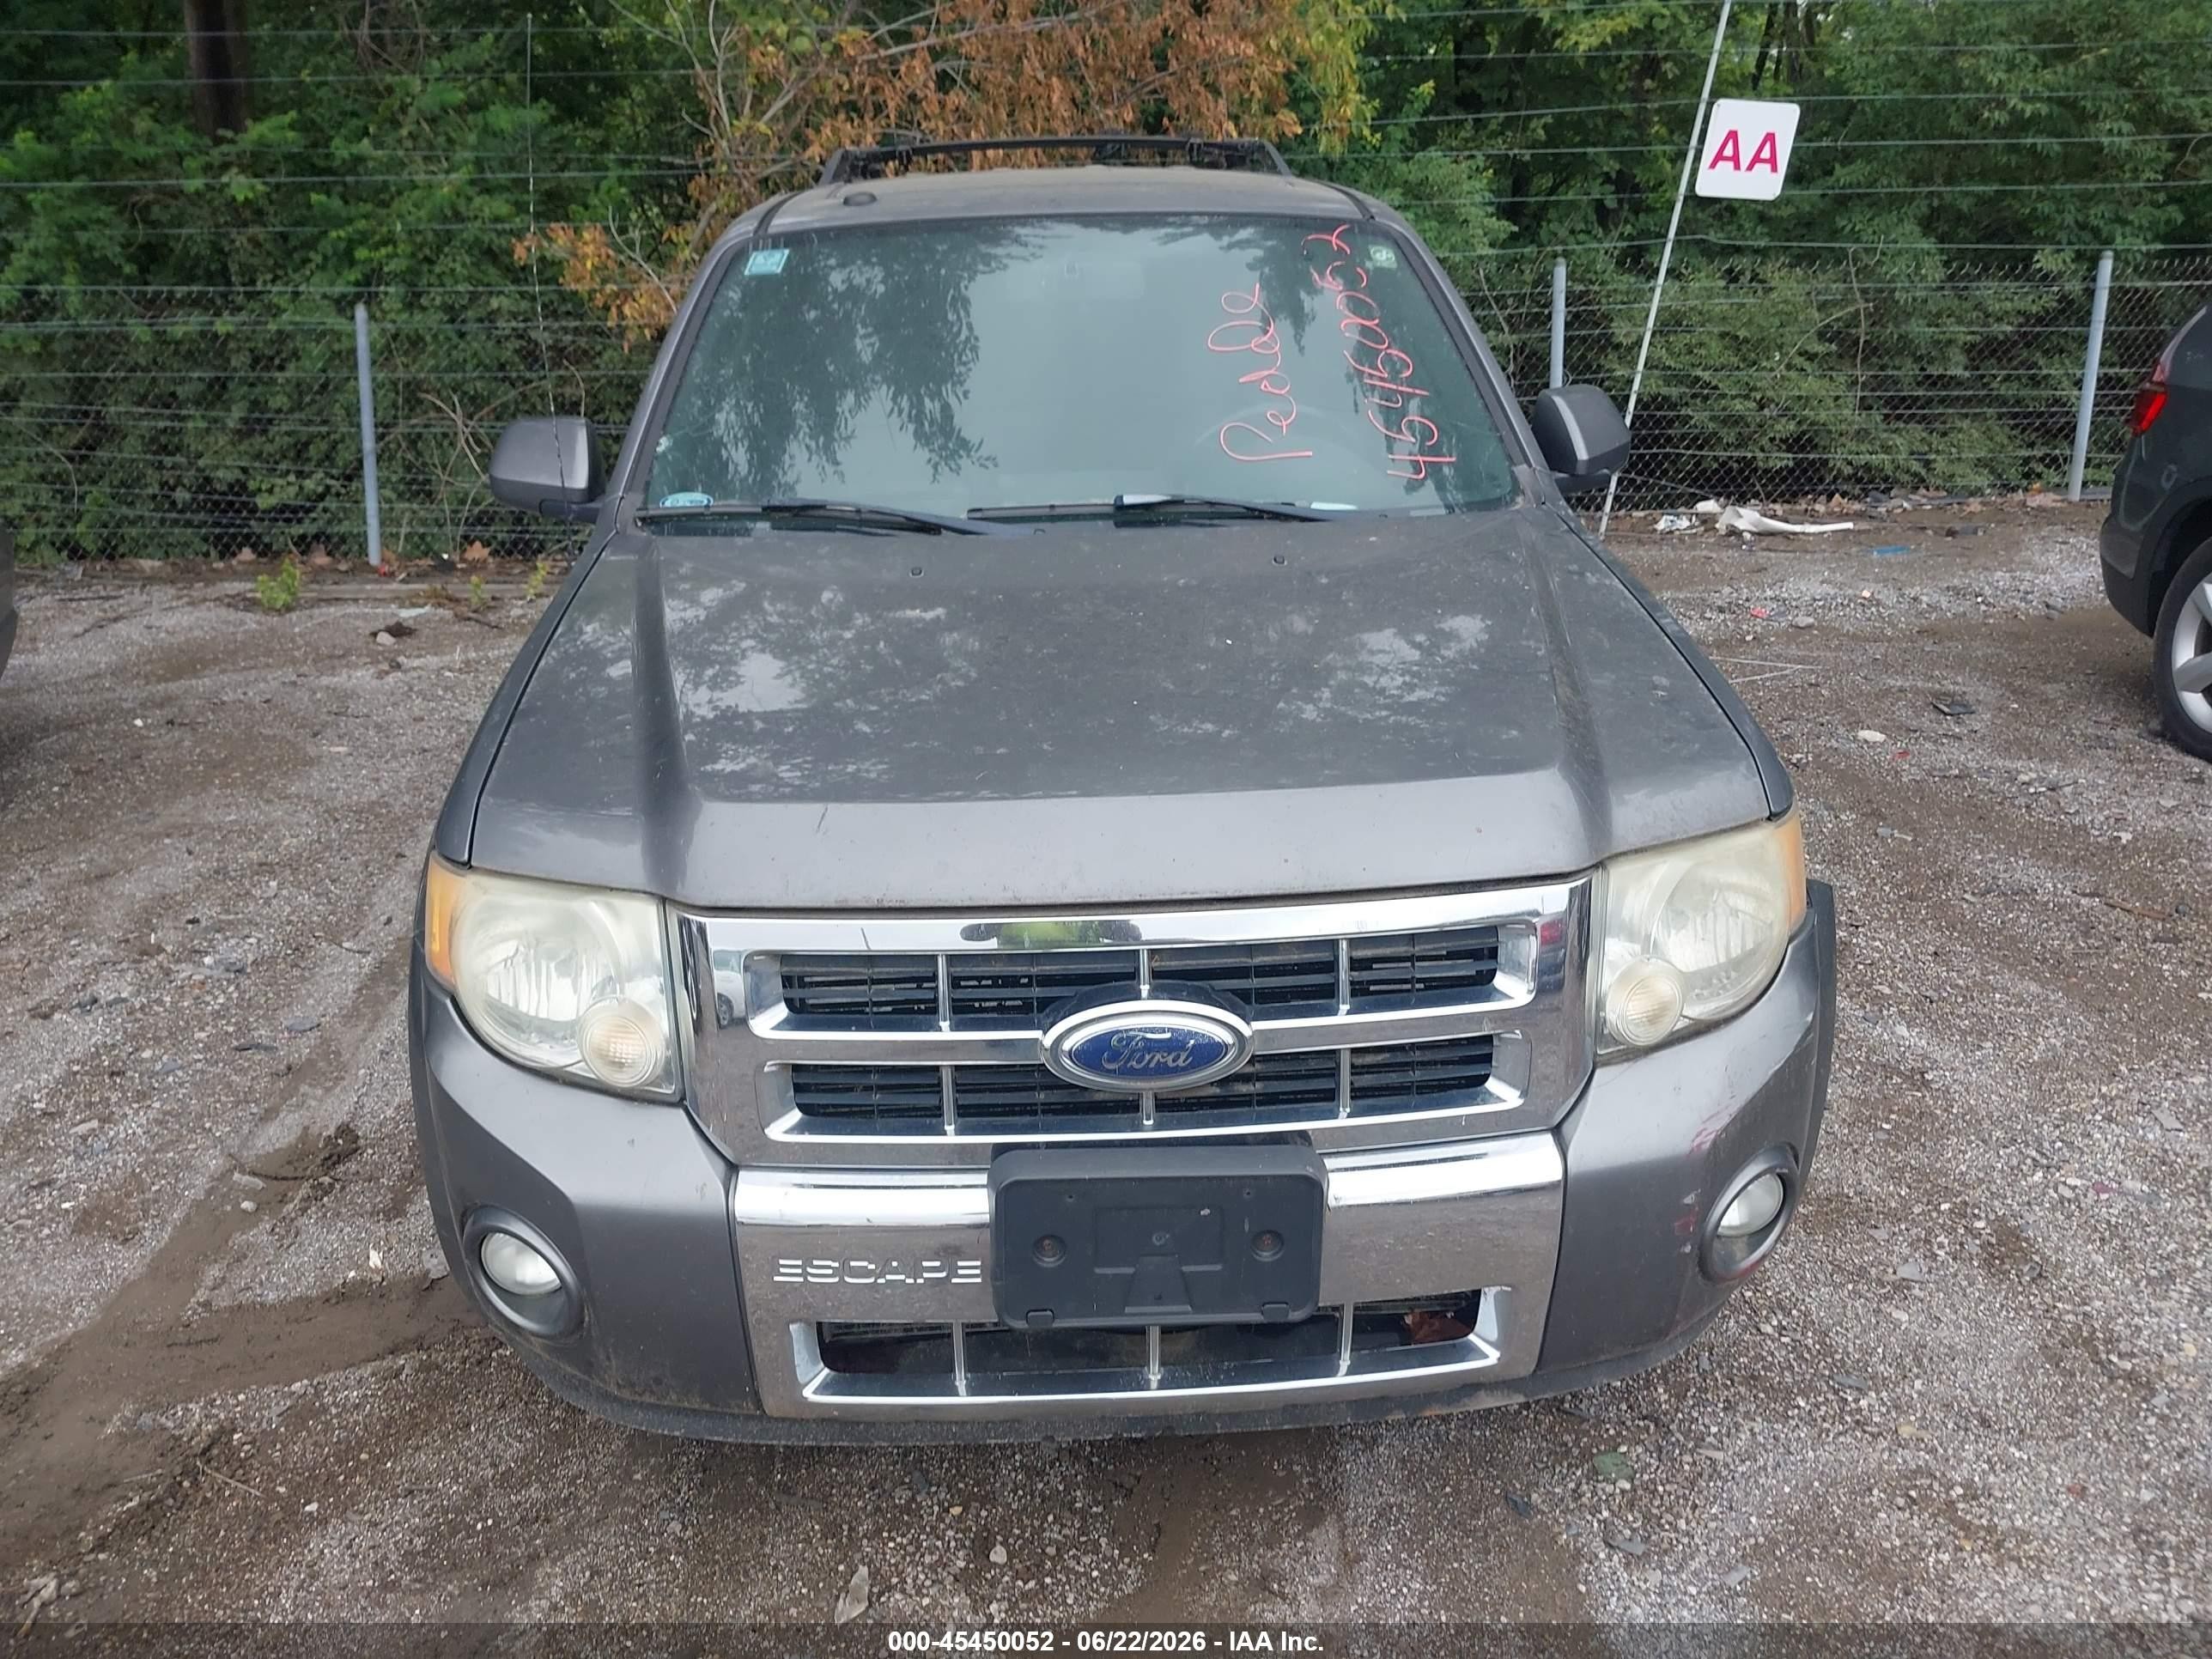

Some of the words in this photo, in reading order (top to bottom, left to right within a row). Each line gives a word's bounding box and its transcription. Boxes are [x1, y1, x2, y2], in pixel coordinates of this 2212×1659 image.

[1708, 130, 1778, 173] AA
[1300, 223, 1457, 480] 45450052
[1102, 1031, 1194, 1071] Ford
[773, 1258, 982, 1284] ESCAPE
